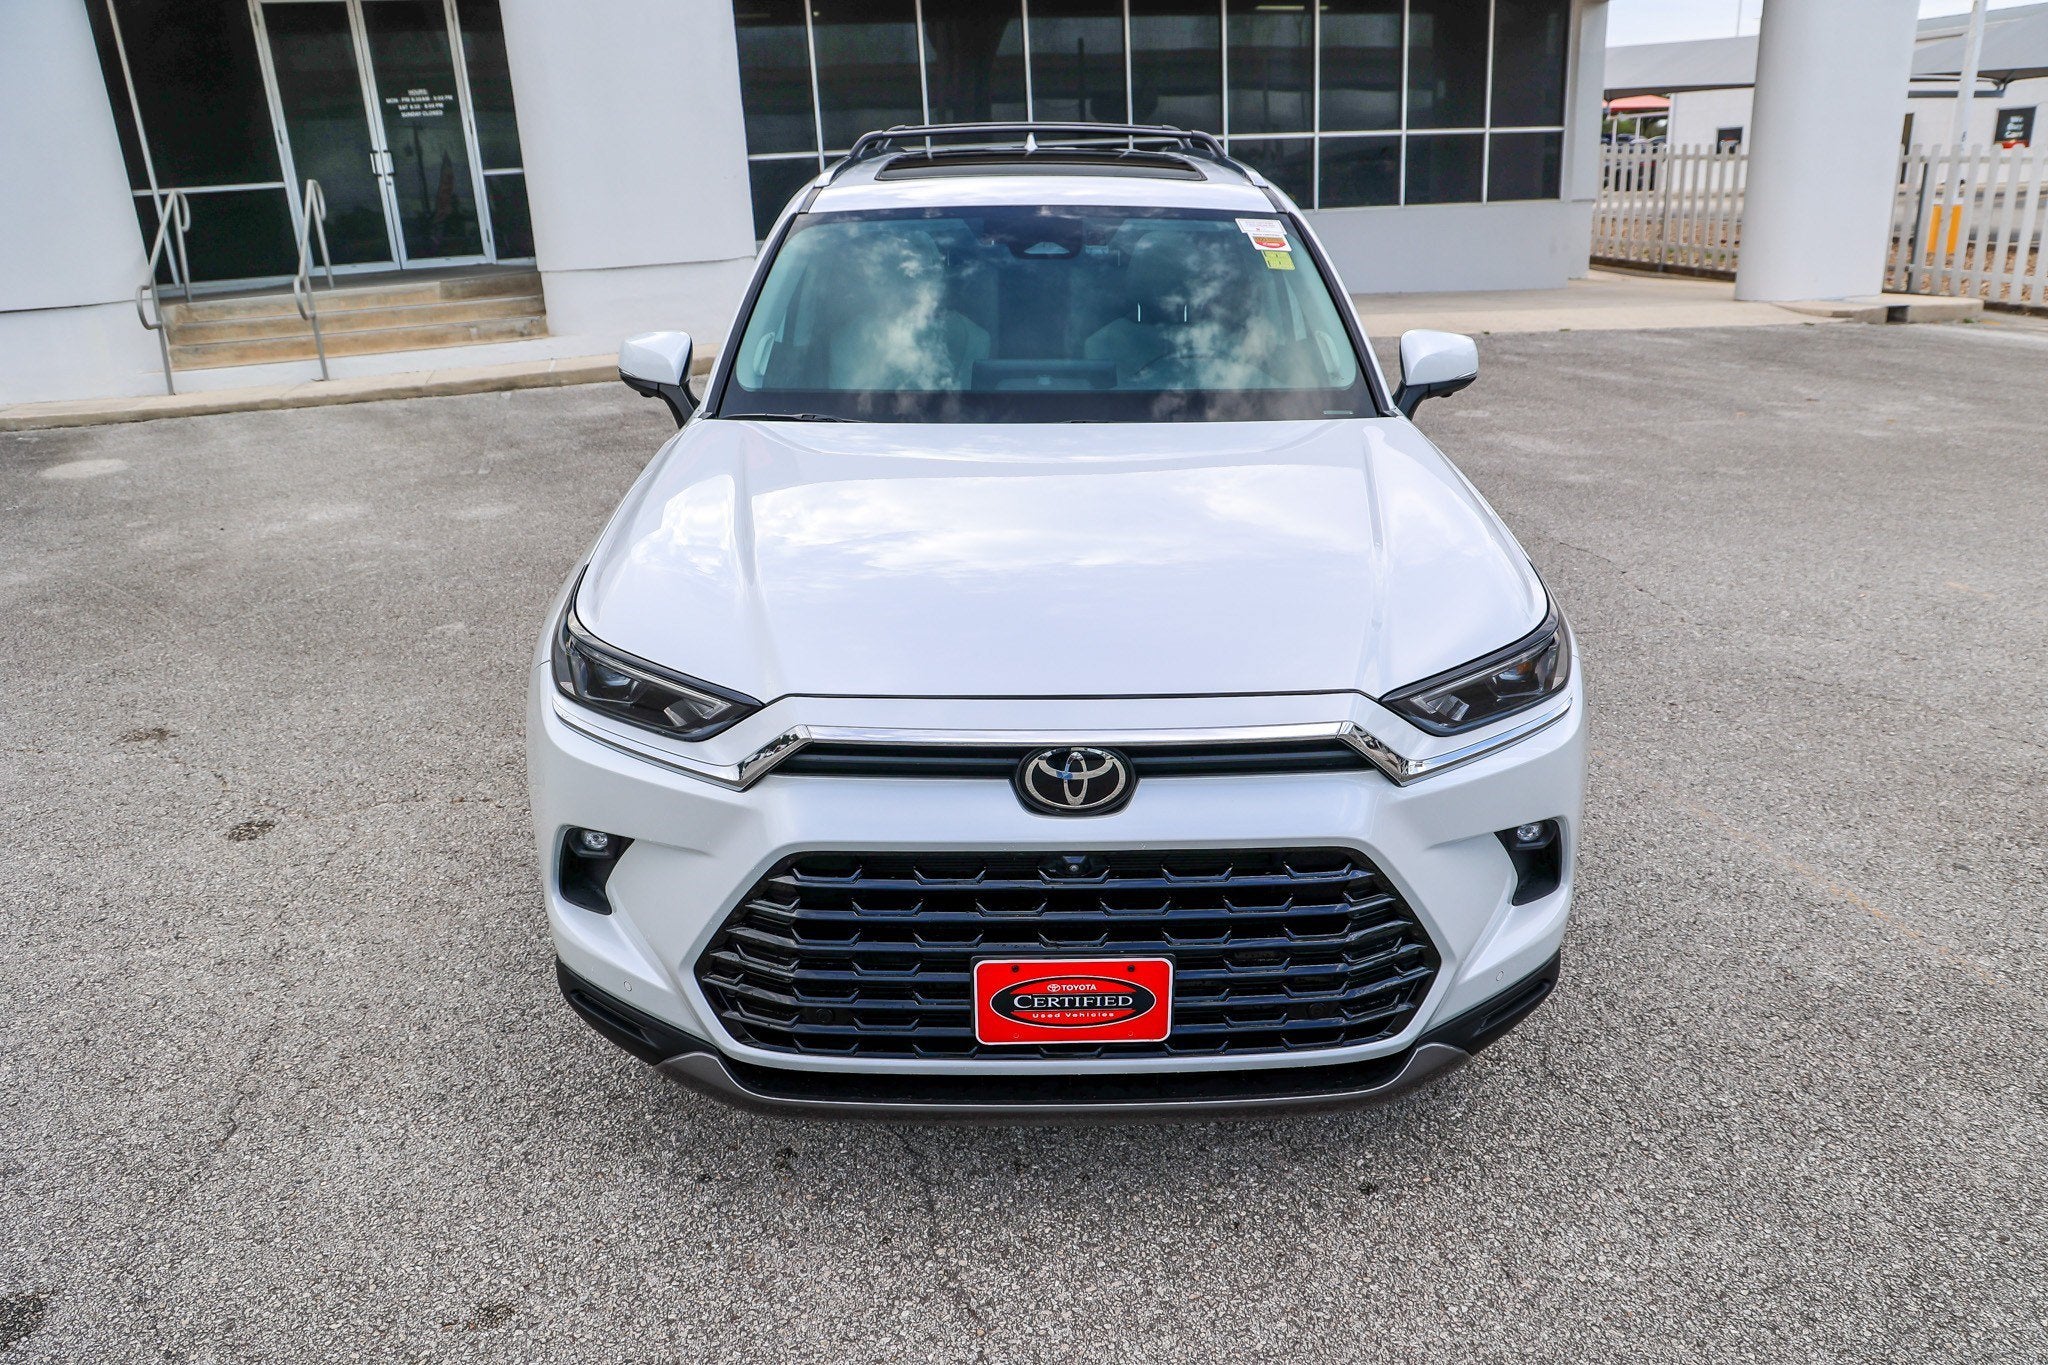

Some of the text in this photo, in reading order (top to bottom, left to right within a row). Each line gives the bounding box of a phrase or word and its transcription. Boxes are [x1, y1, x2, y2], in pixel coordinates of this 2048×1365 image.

[2007, 122, 2024, 131] Buy
[2004, 130, 2024, 139] Cars
[1013, 994, 1133, 1009] CERTIFIED
